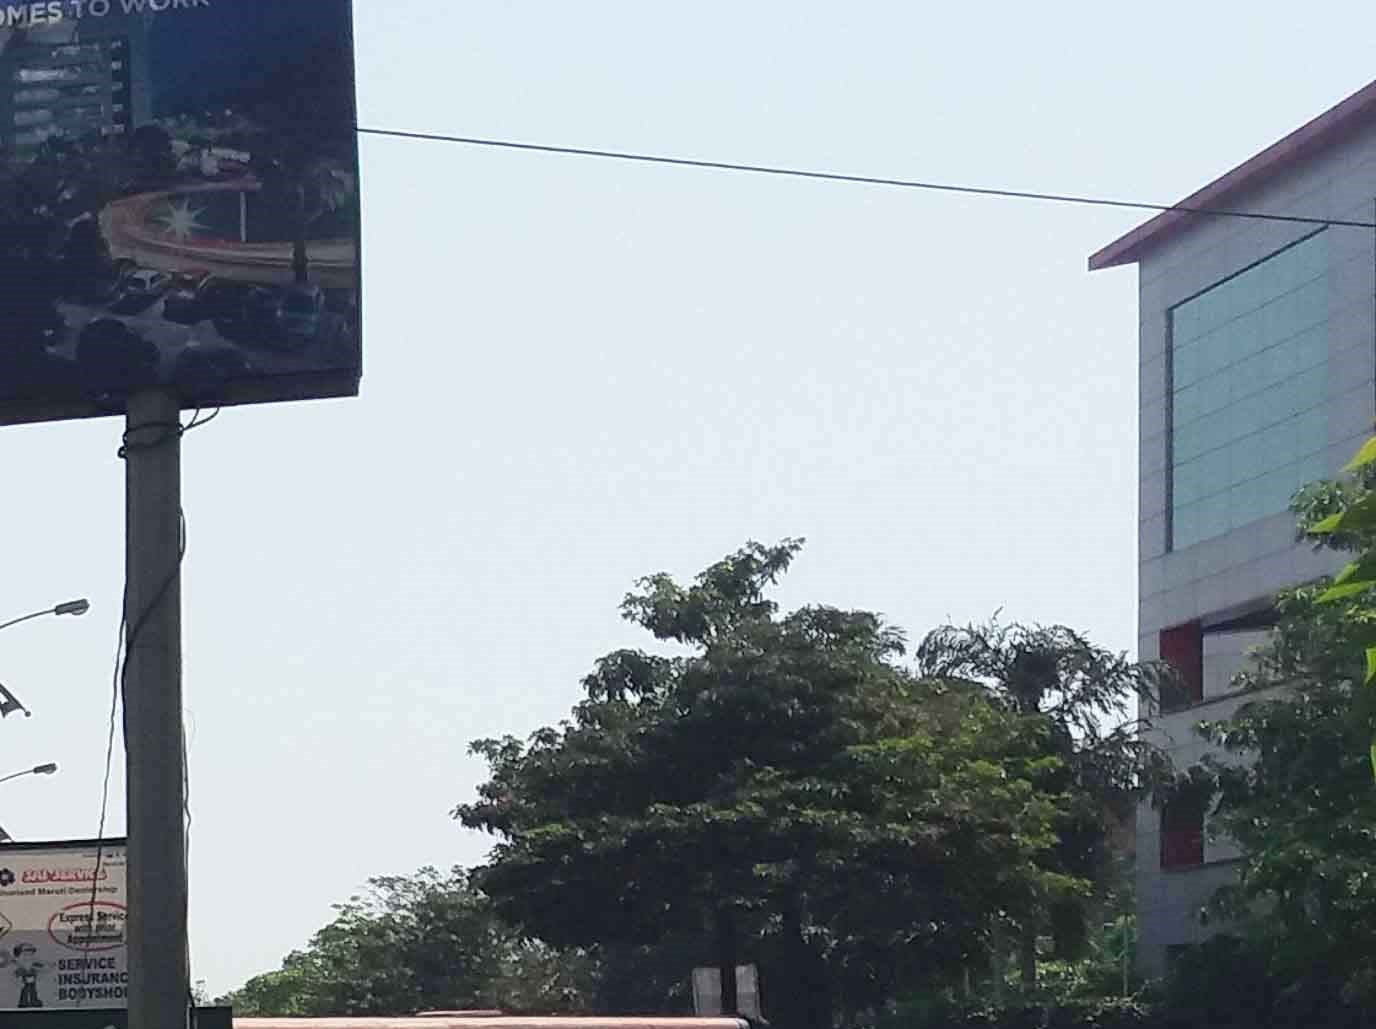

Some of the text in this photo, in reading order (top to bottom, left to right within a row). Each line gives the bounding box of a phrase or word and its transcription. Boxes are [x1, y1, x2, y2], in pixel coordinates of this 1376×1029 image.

[67, 0, 109, 18] TO
[58, 957, 116, 971] SERVICE
[58, 973, 128, 985] INSURANC
